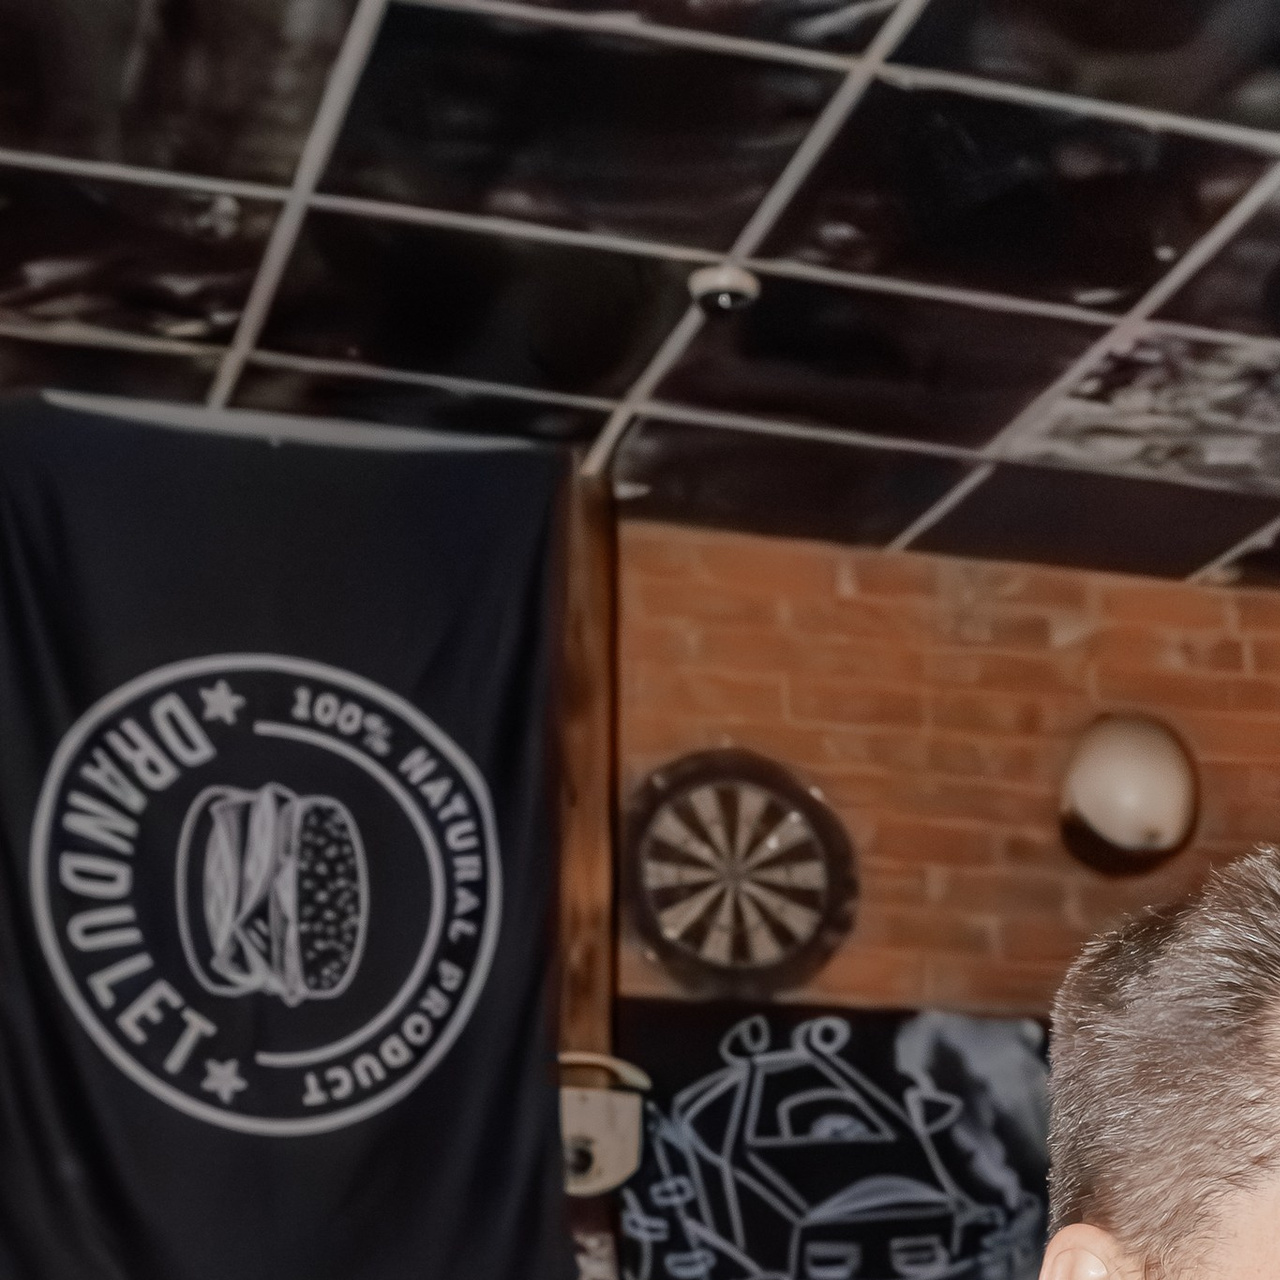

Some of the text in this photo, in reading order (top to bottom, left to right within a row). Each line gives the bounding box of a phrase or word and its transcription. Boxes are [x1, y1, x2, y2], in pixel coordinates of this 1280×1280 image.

[58, 692, 217, 1075] DRANDULET
[292, 687, 483, 1106] 100% NATURAL PRODUCT
